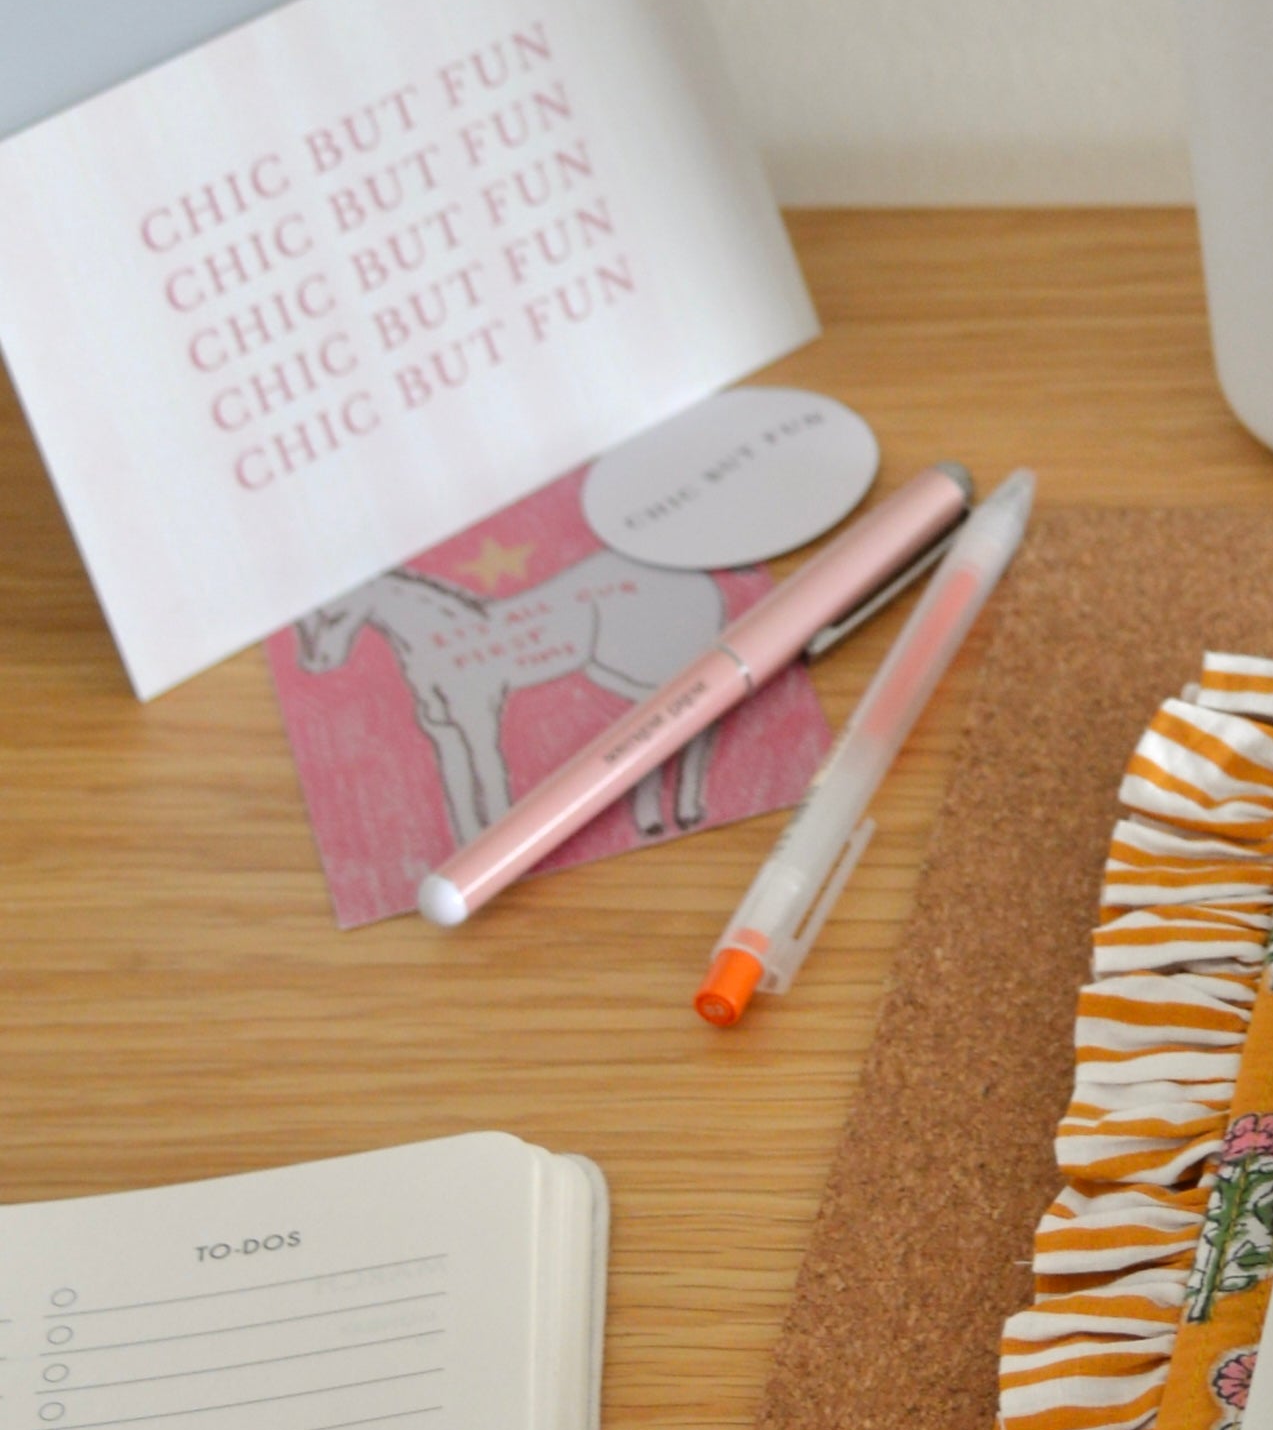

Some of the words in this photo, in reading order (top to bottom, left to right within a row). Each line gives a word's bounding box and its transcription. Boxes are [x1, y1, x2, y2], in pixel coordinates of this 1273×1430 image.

[139, 153, 292, 254] CHIC
[305, 83, 420, 176] BUT
[438, 20, 553, 109] FUN
[163, 212, 315, 314] CHIC
[327, 142, 442, 235] BUT
[459, 79, 574, 169] FUN
[187, 272, 339, 374] CHIC
[350, 202, 463, 295] BUT
[480, 138, 595, 228] FUN
[209, 332, 361, 434] CHIC
[372, 260, 486, 354] BUT
[502, 195, 617, 287] FUN
[233, 390, 383, 493] CHIC
[394, 319, 507, 412] BUT
[523, 253, 638, 343] FUN
[702, 443, 757, 485] BUT
[194, 1229, 302, 1263] TO-DOS
